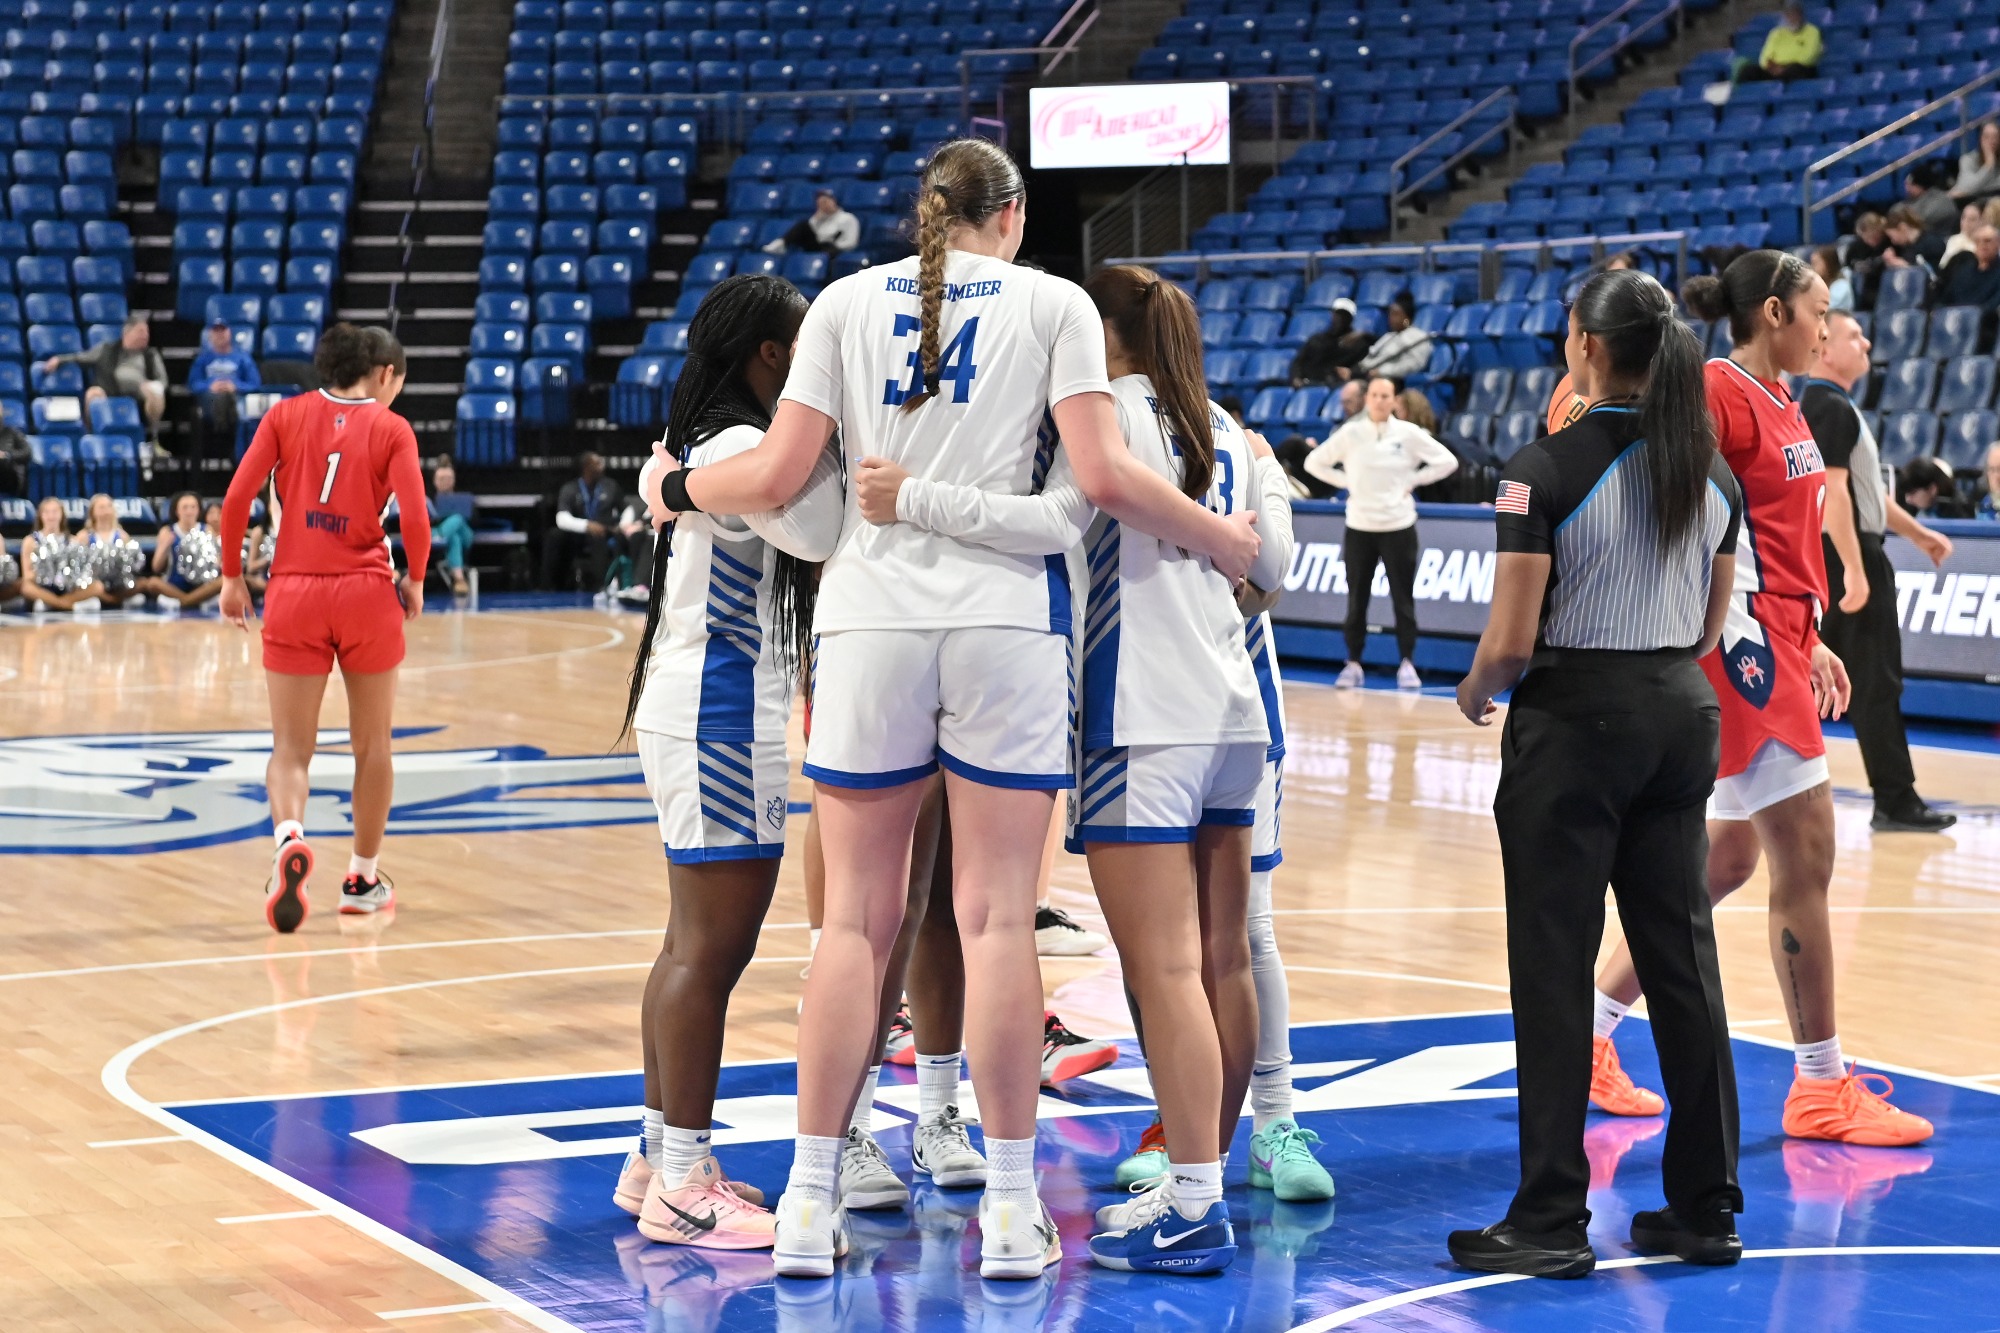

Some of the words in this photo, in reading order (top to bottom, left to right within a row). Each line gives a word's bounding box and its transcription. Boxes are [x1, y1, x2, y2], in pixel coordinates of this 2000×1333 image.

[882, 313, 980, 405] 34
[319, 451, 342, 504] 1
[1412, 547, 1497, 604] BAN
